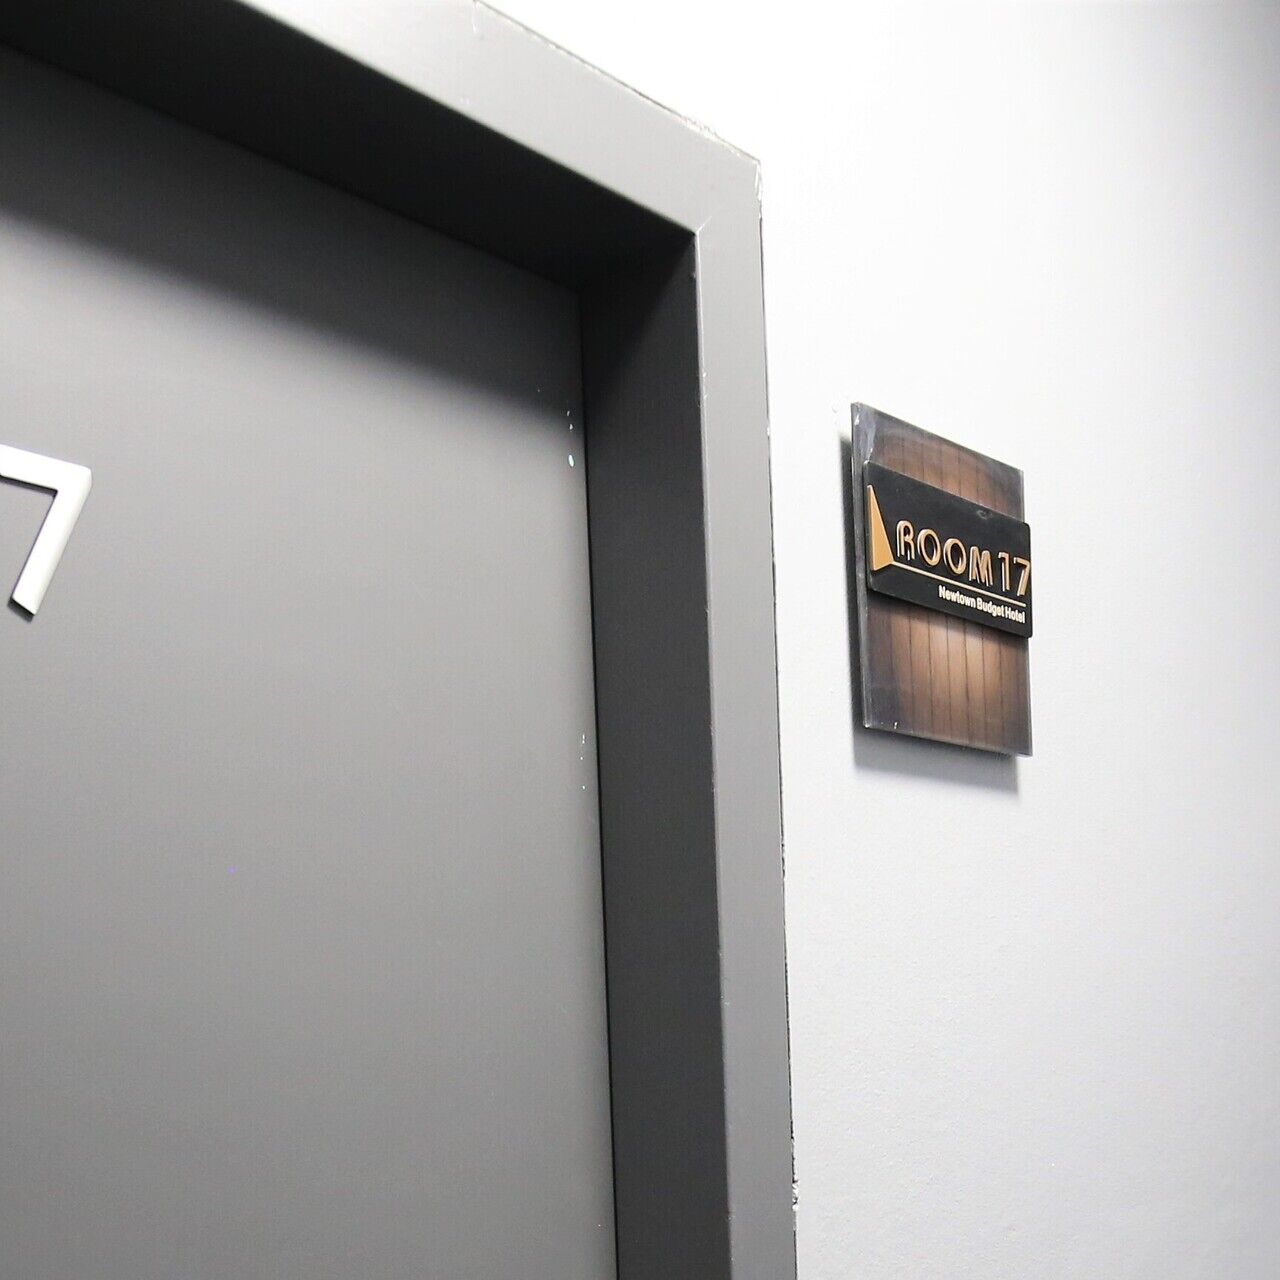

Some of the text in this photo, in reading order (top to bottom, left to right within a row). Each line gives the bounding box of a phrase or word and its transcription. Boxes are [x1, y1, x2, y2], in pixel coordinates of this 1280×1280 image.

[896, 520, 1031, 596] ROOM 17
[938, 585, 1026, 623] Newtown Budget Hotel
